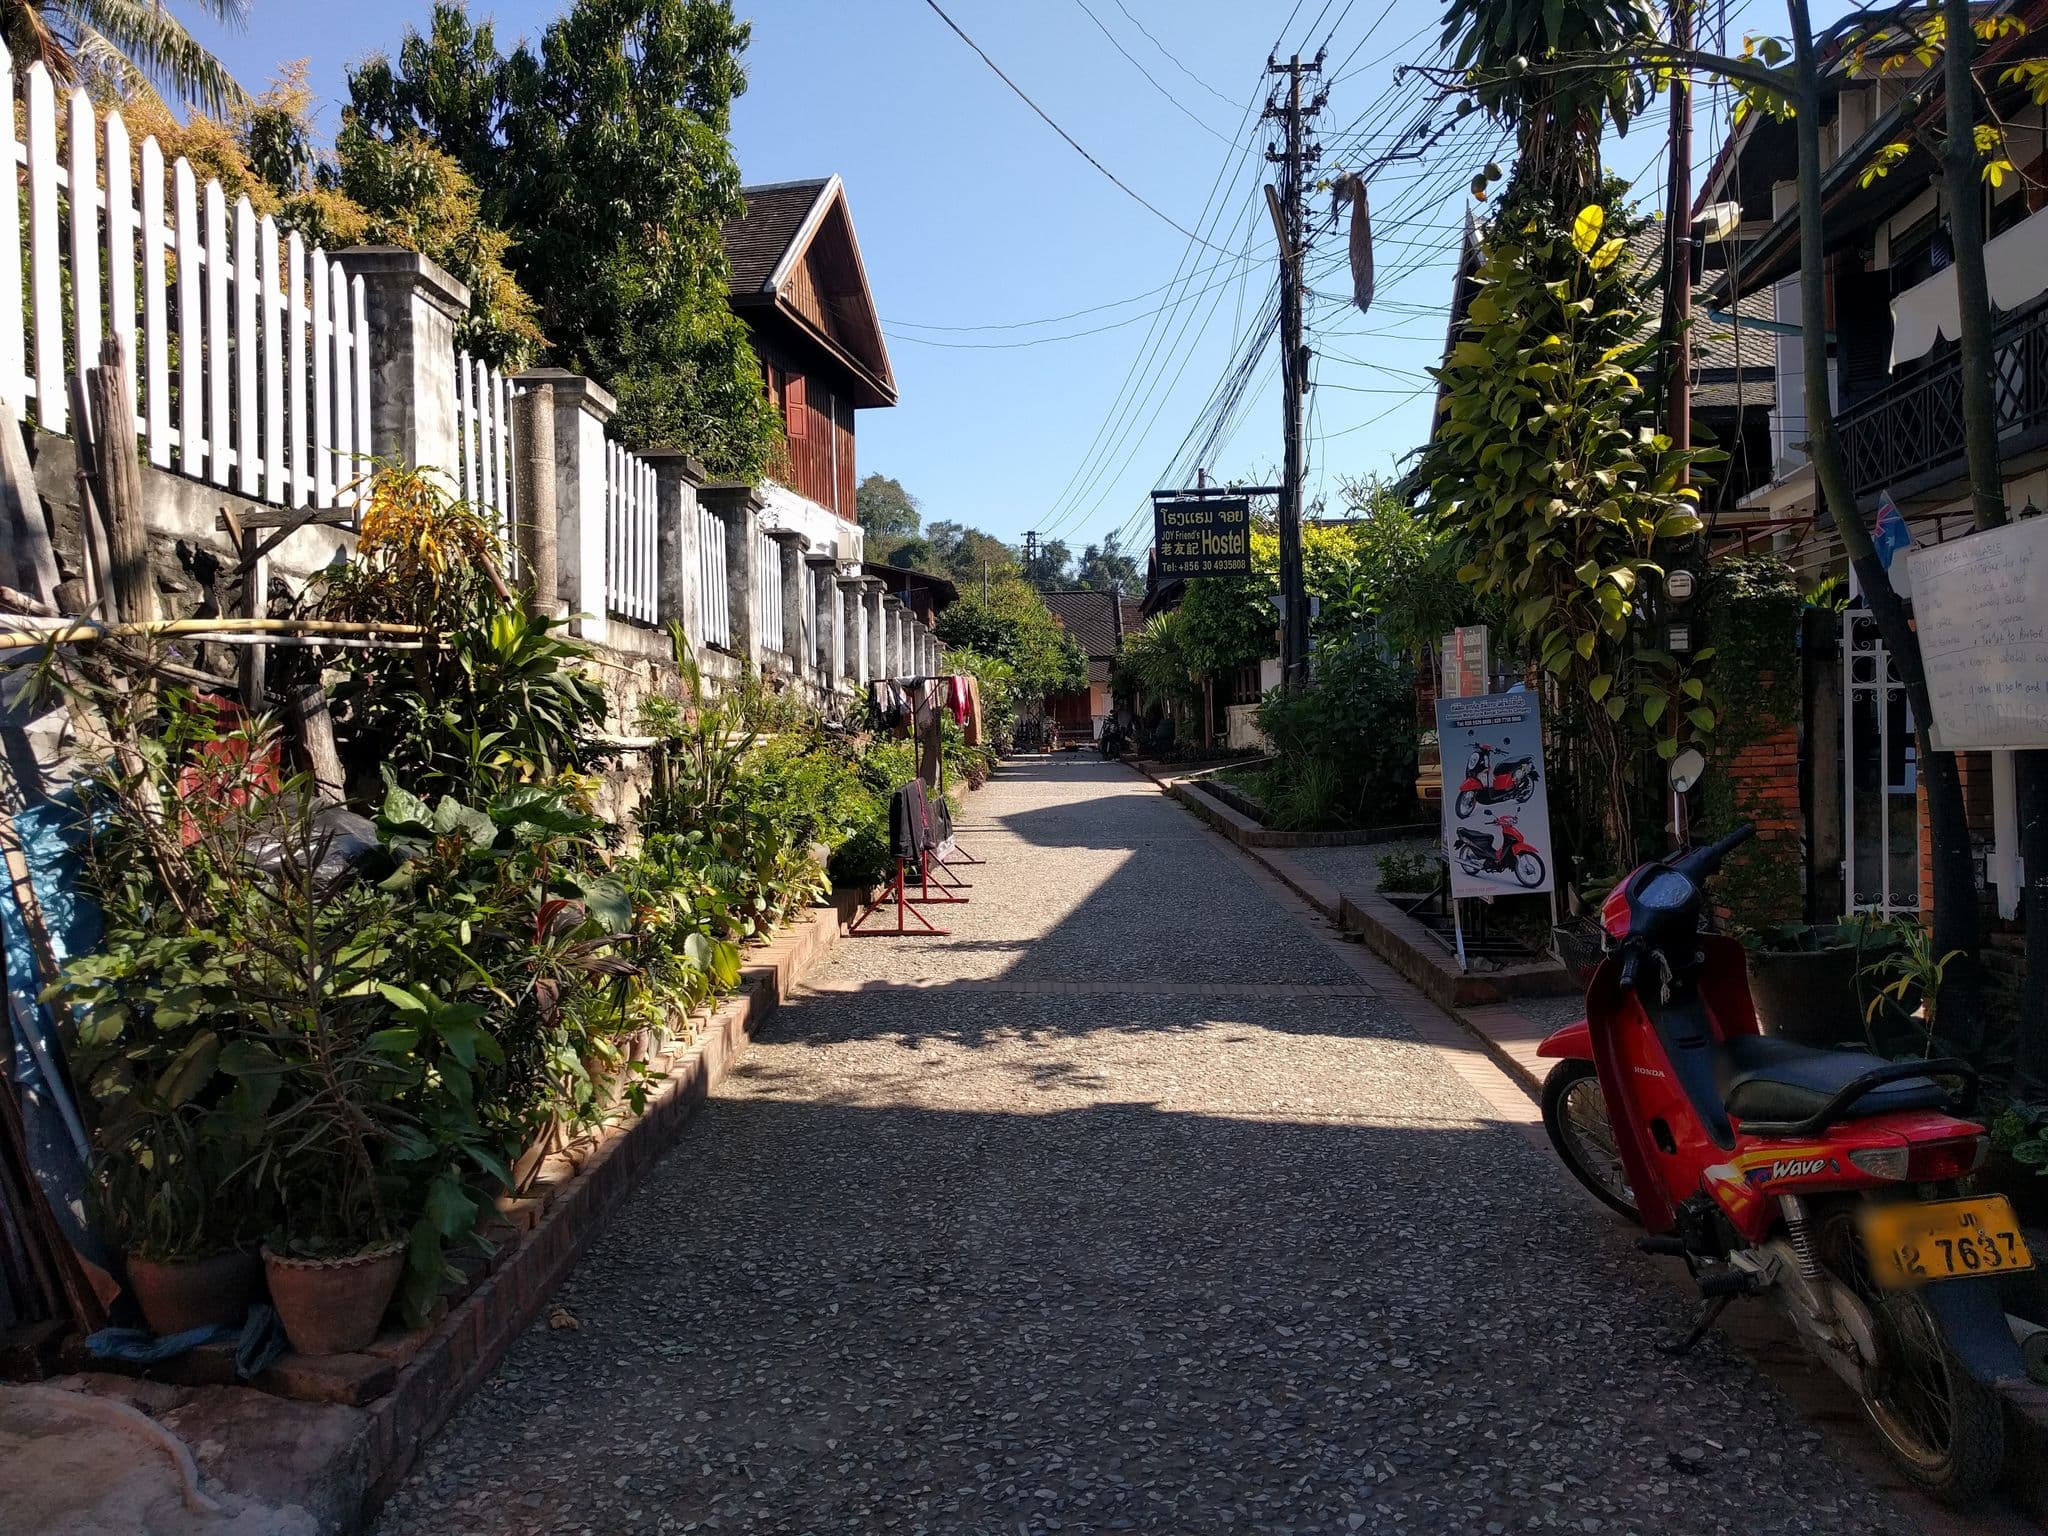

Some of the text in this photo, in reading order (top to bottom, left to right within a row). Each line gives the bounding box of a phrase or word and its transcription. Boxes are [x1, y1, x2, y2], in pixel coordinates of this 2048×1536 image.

[1161, 531, 1175, 541] JOY
[1201, 529, 1245, 555] Hostel
[1161, 542, 1200, 556] 老友記
[1162, 562, 1177, 573] Tel:
[1178, 561, 1200, 572] +856
[1634, 1066, 1666, 1078] HONDA
[1772, 1159, 1826, 1179] Wave
[1935, 1231, 2018, 1273] 7637
